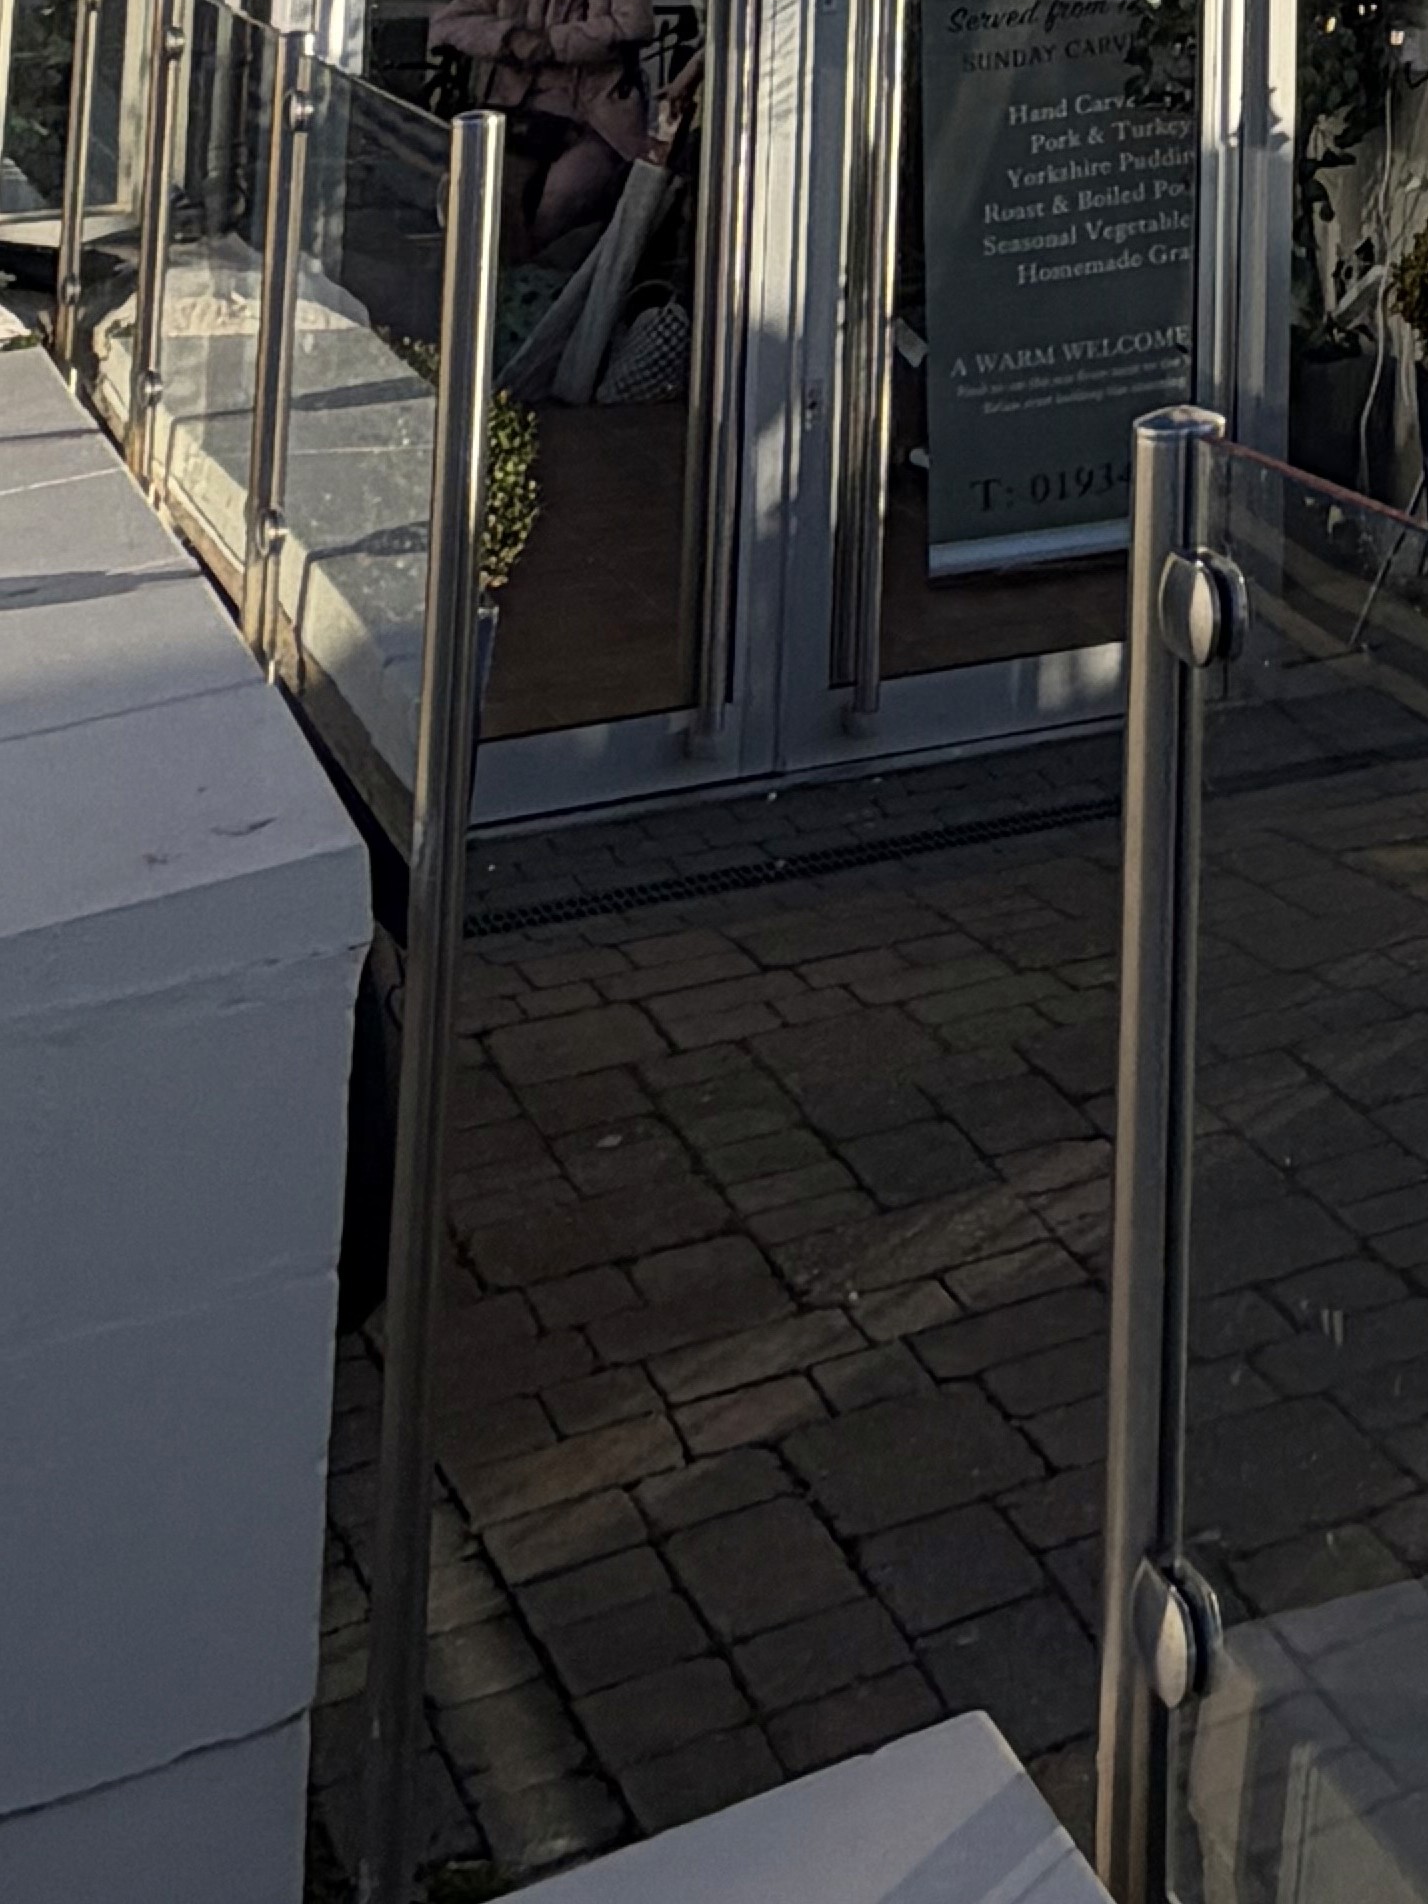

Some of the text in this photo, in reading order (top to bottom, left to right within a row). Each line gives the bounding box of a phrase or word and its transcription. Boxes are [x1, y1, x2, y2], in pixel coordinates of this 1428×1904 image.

[948, 0, 1038, 34] Served
[962, 45, 1058, 74] SUNDAY
[1008, 98, 1068, 127] Hand
[1030, 116, 1191, 155] Pork & Turkey
[1006, 159, 1112, 189] Yorkshire
[984, 200, 1045, 225] Roast
[1052, 195, 1070, 216] &
[1078, 181, 1146, 212] Boiled
[982, 224, 1077, 257] Seasonal
[1016, 248, 1142, 286] Homemade
[950, 357, 968, 379] A
[975, 345, 1055, 376] WARM
[1061, 324, 1191, 362] WELCOME
[968, 477, 1014, 512] T:
